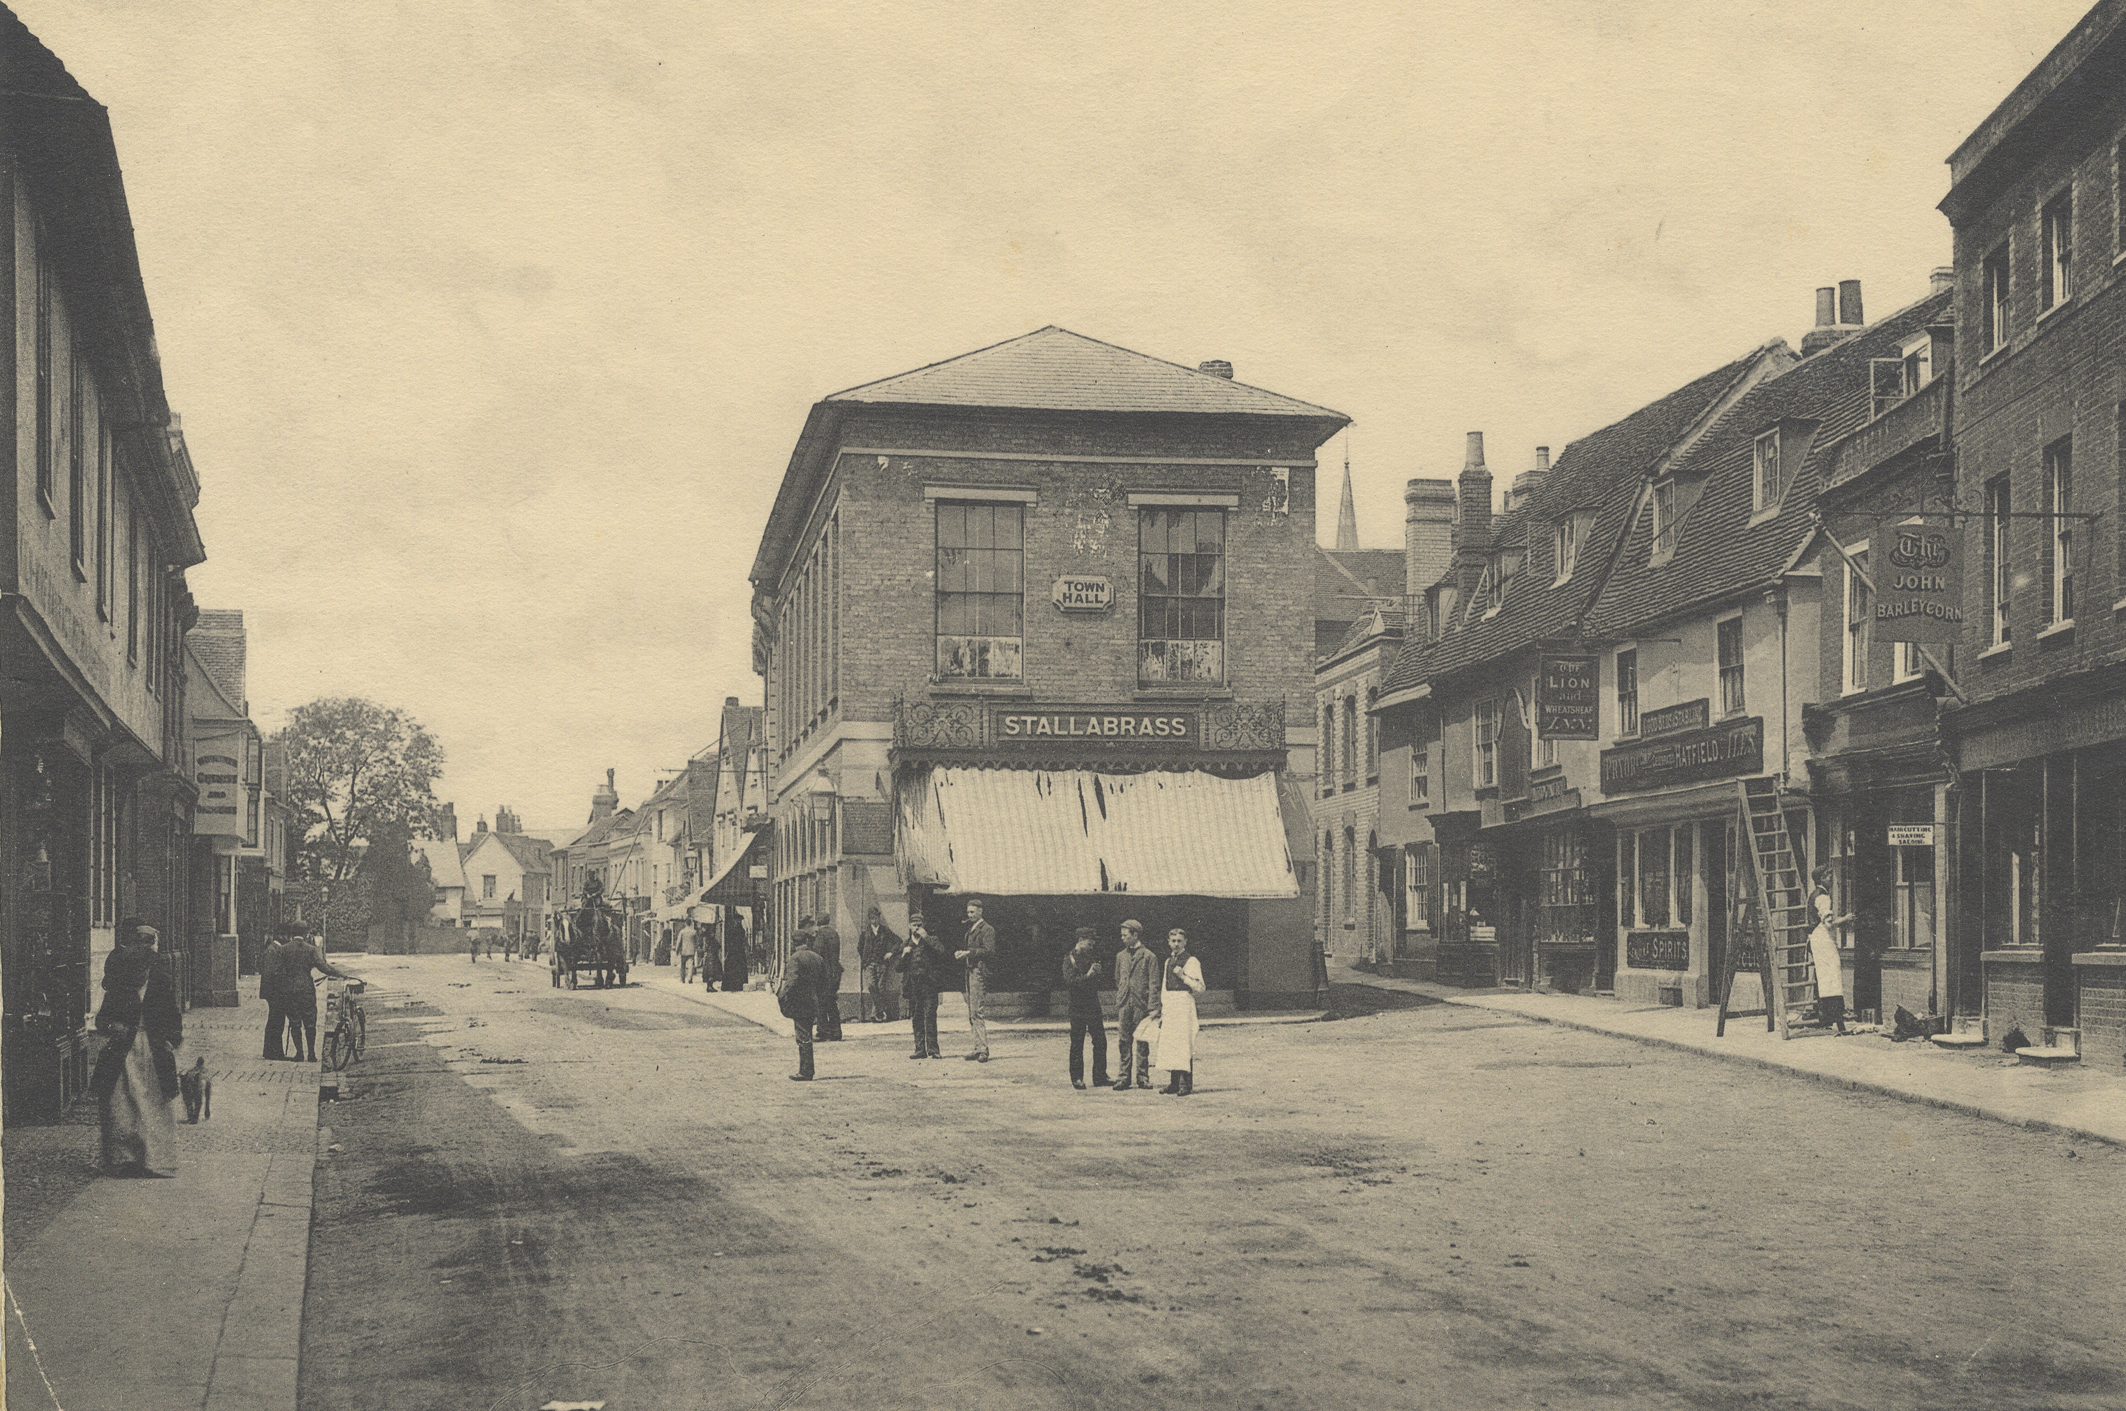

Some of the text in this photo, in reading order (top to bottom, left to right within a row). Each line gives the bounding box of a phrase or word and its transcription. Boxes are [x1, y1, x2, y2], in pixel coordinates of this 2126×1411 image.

[1899, 532, 1945, 561] The
[1064, 581, 1105, 593] TOWN
[1893, 575, 1945, 591] JOHN
[1062, 593, 1104, 604] HALL
[1877, 599, 1962, 620] BARLEYCORN
[1549, 675, 1590, 689] LION
[1544, 704, 1594, 715] WHEATSHEAF
[1005, 716, 1186, 736] STALLABRASS
